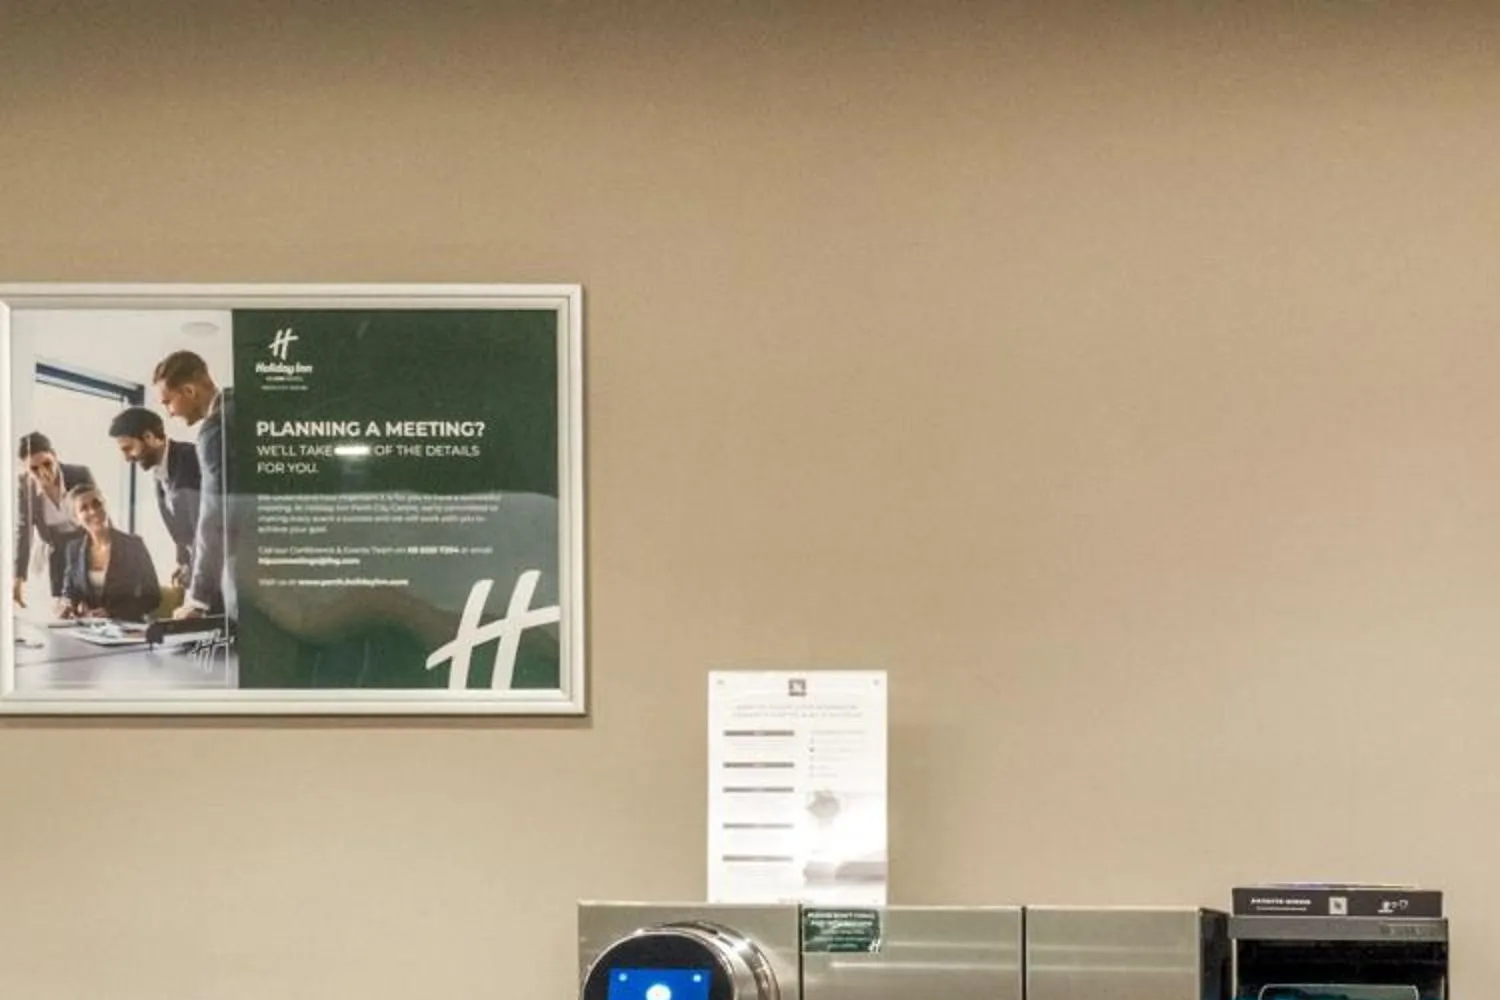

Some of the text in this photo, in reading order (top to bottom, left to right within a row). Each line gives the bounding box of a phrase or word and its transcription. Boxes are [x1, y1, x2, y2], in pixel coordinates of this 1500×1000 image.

[255, 362, 313, 375] Holiday Inn
[256, 421, 486, 437] PLANNING A MEETING?
[257, 445, 296, 457] WE'LL
[300, 445, 334, 457] TAKE
[374, 445, 394, 457] OF
[396, 445, 422, 457] THE
[426, 445, 480, 457] DETAILS
[257, 462, 319, 474] FOR YOU.
